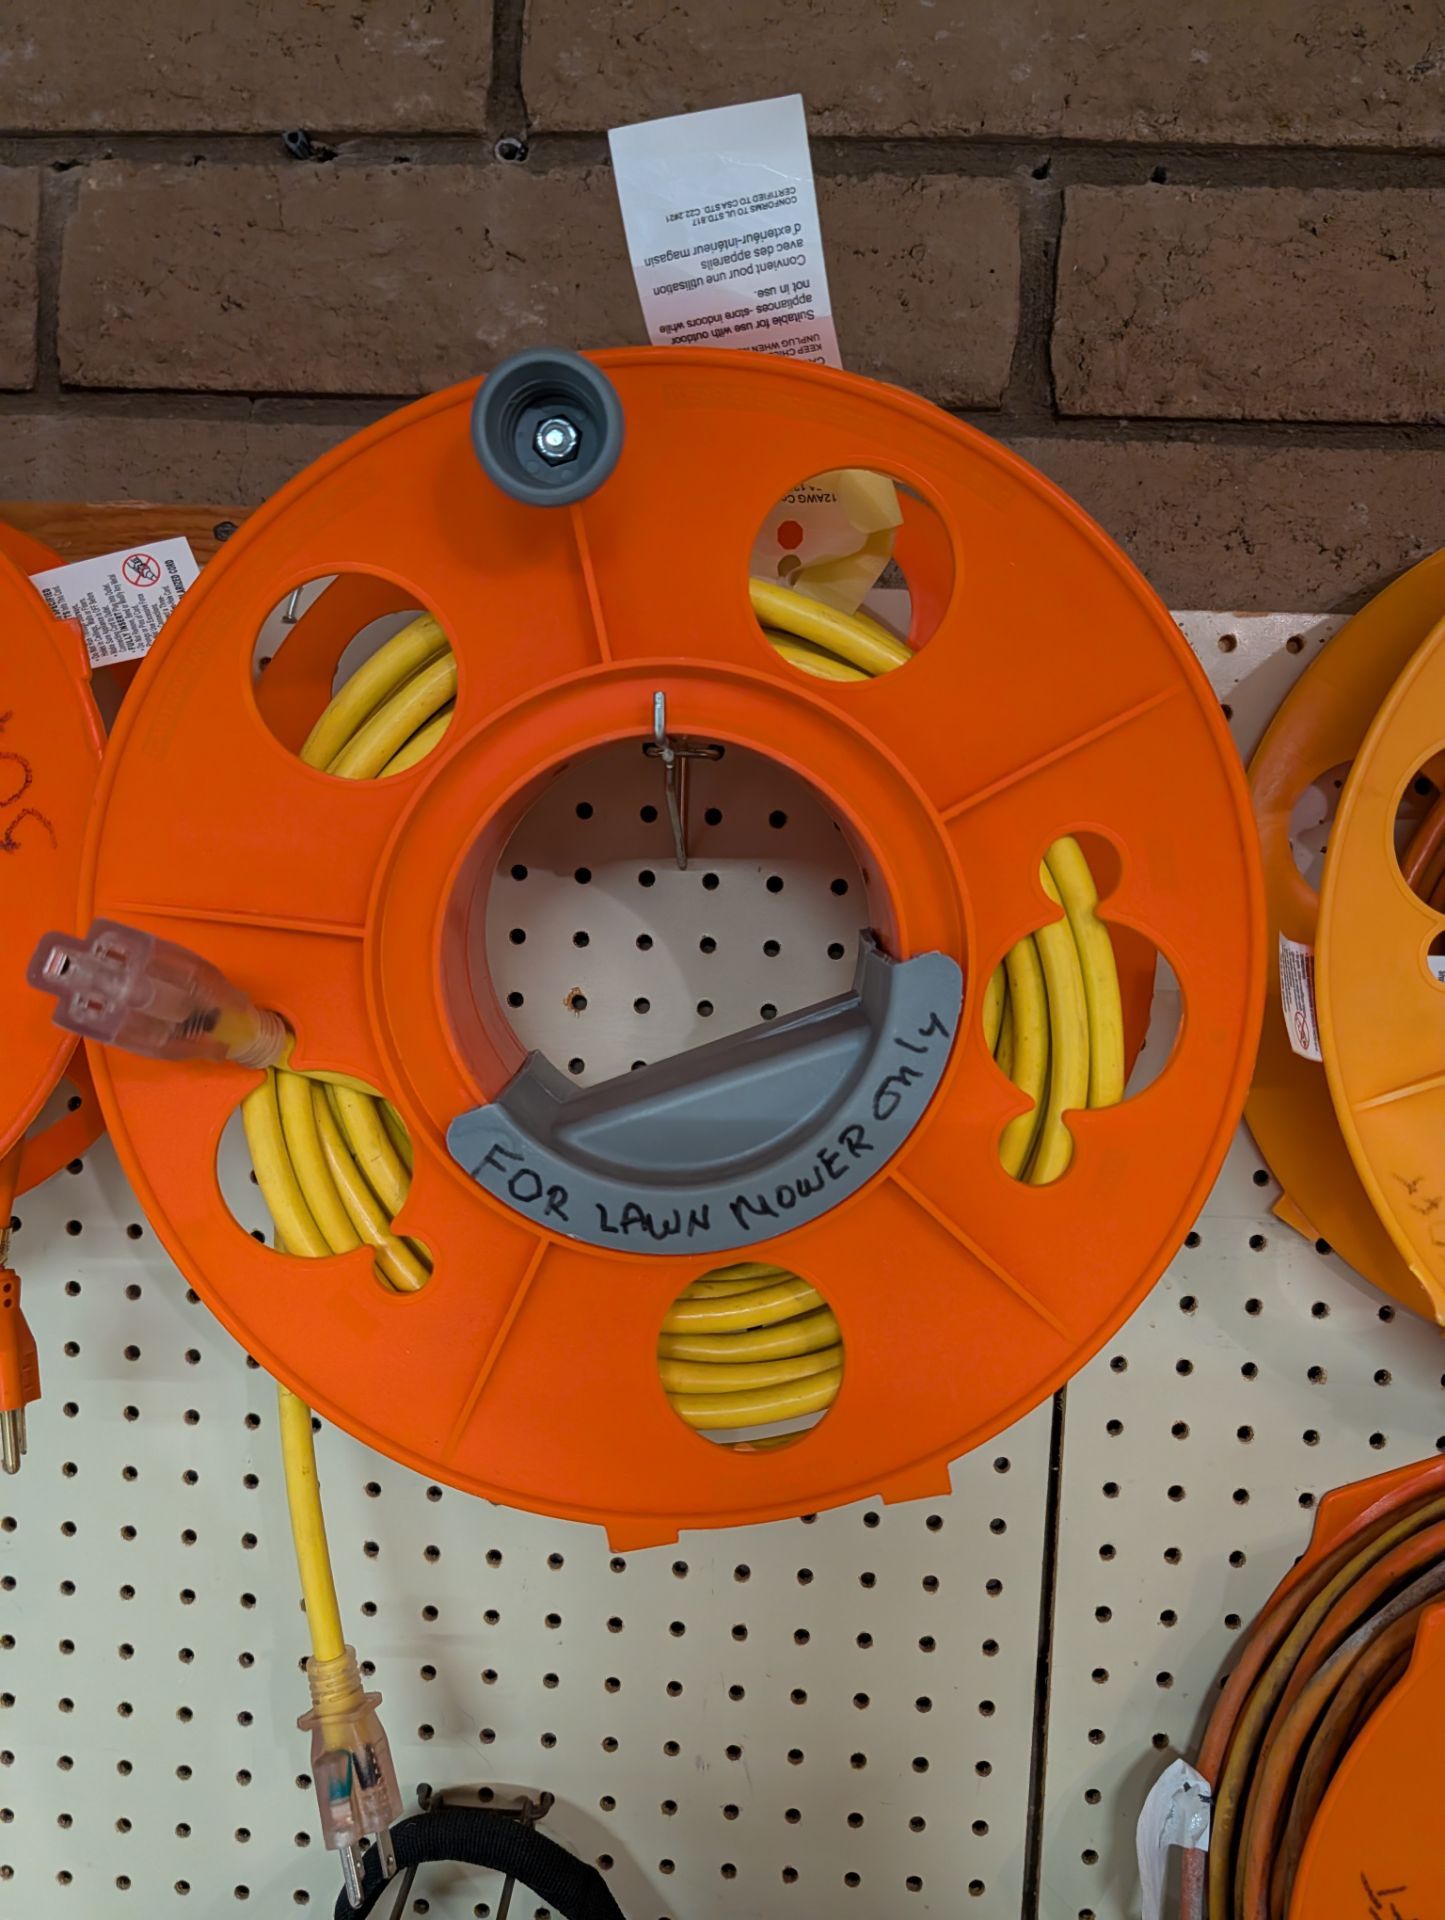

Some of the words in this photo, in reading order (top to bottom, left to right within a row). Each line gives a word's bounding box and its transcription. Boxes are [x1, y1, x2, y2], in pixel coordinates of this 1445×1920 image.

[739, 197, 751, 205] TO
[752, 187, 796, 203] CERTIFIED
[721, 199, 738, 209] CSA
[750, 196, 797, 213] CONFORMS
[725, 210, 736, 218] UL
[737, 207, 749, 216] TO
[753, 245, 774, 257] des
[776, 239, 803, 252] avec
[644, 249, 690, 267] magasin
[701, 250, 751, 269] appareils
[756, 254, 806, 274] Convient
[729, 263, 754, 279] pour
[706, 272, 726, 284] une
[653, 278, 704, 295] utilisation
[754, 287, 777, 298] use.
[779, 284, 790, 294] in
[792, 280, 810, 292] not
[756, 294, 812, 314] appliances
[686, 314, 723, 328] indoors
[756, 319, 770, 329] for
[772, 310, 814, 326] Suitable
[659, 322, 685, 334] while
[711, 327, 732, 338] with
[734, 322, 753, 332] use
[672, 331, 709, 345] outdoor
[781, 333, 820, 348] UNPLUG
[751, 342, 780, 354] WHEN
[797, 344, 822, 354] KEEP
[797, 492, 836, 503] 12AWG
[164, 560, 178, 574] CORD
[114, 613, 128, 632] INSERT
[123, 633, 135, 650] FULLY
[472, 1143, 569, 1222] FOR
[595, 1200, 710, 1240] LAWN
[730, 1123, 874, 1230] MOWER
